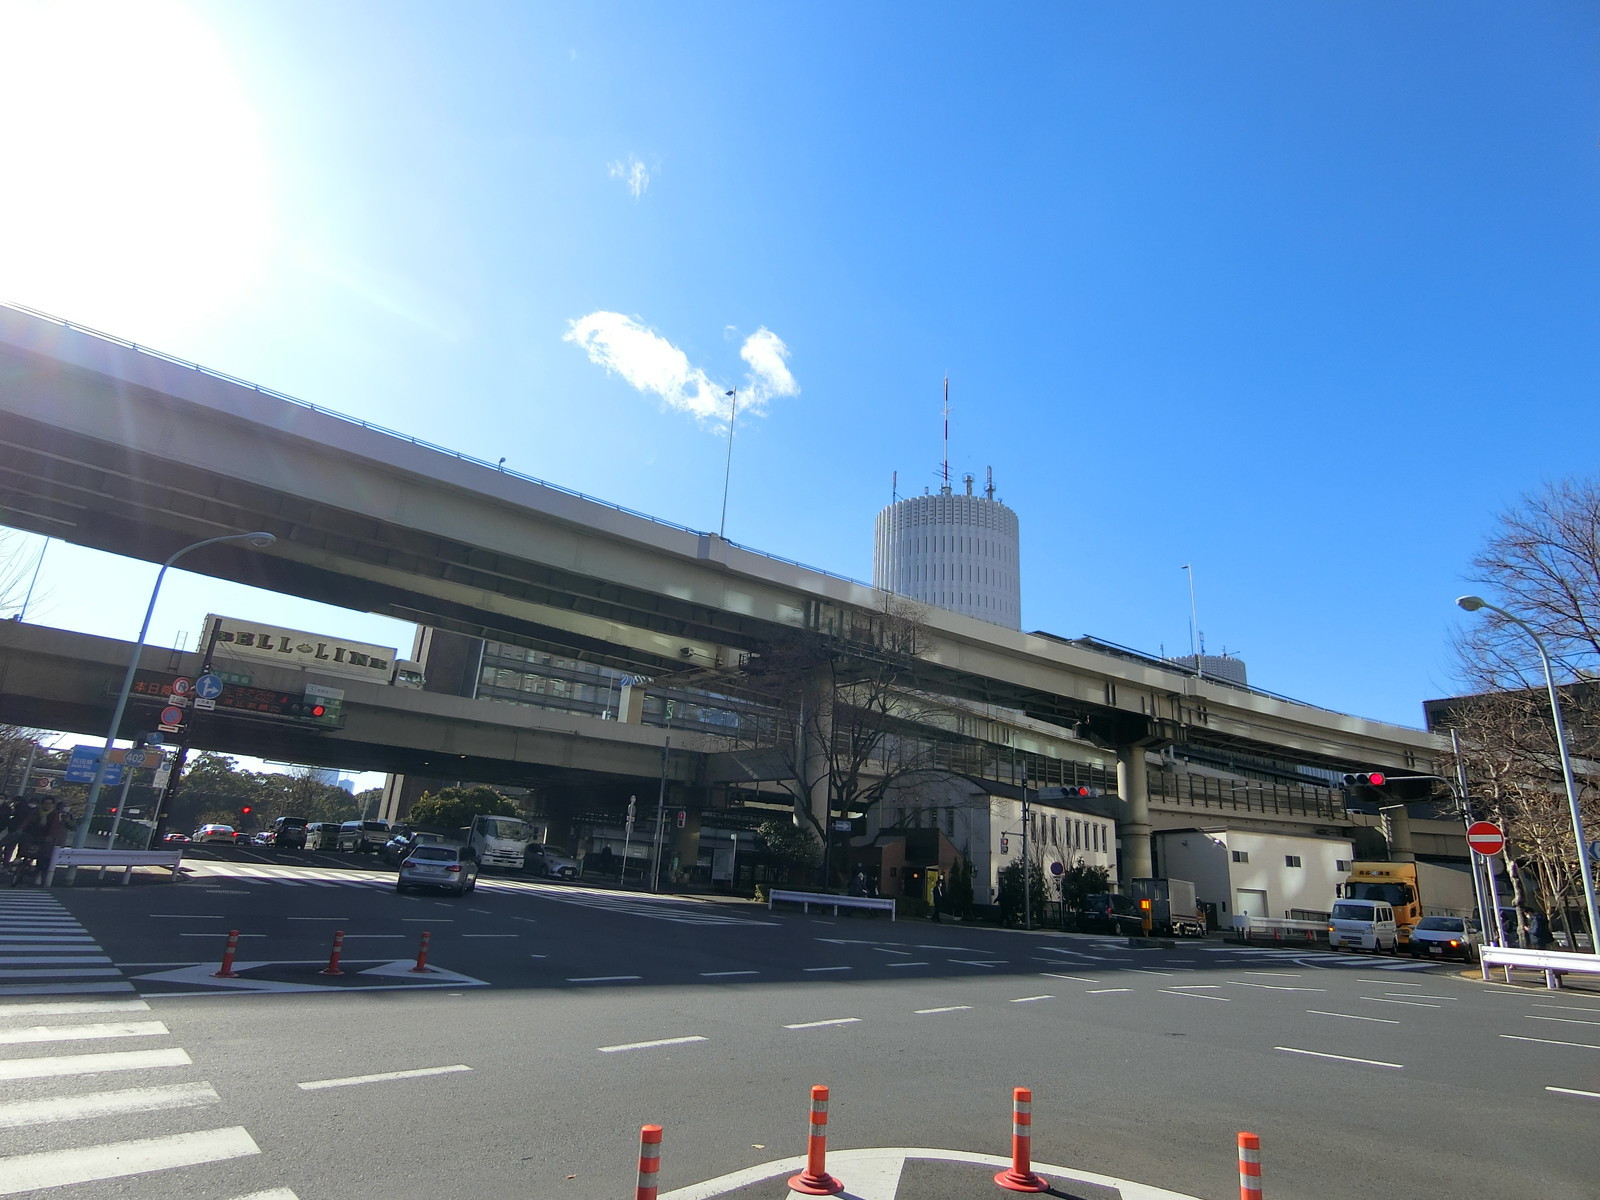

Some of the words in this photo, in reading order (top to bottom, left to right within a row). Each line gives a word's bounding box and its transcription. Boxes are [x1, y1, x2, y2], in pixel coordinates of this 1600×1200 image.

[211, 630, 293, 654] BELL
[315, 642, 388, 670] LINE
[126, 753, 144, 764] 402
